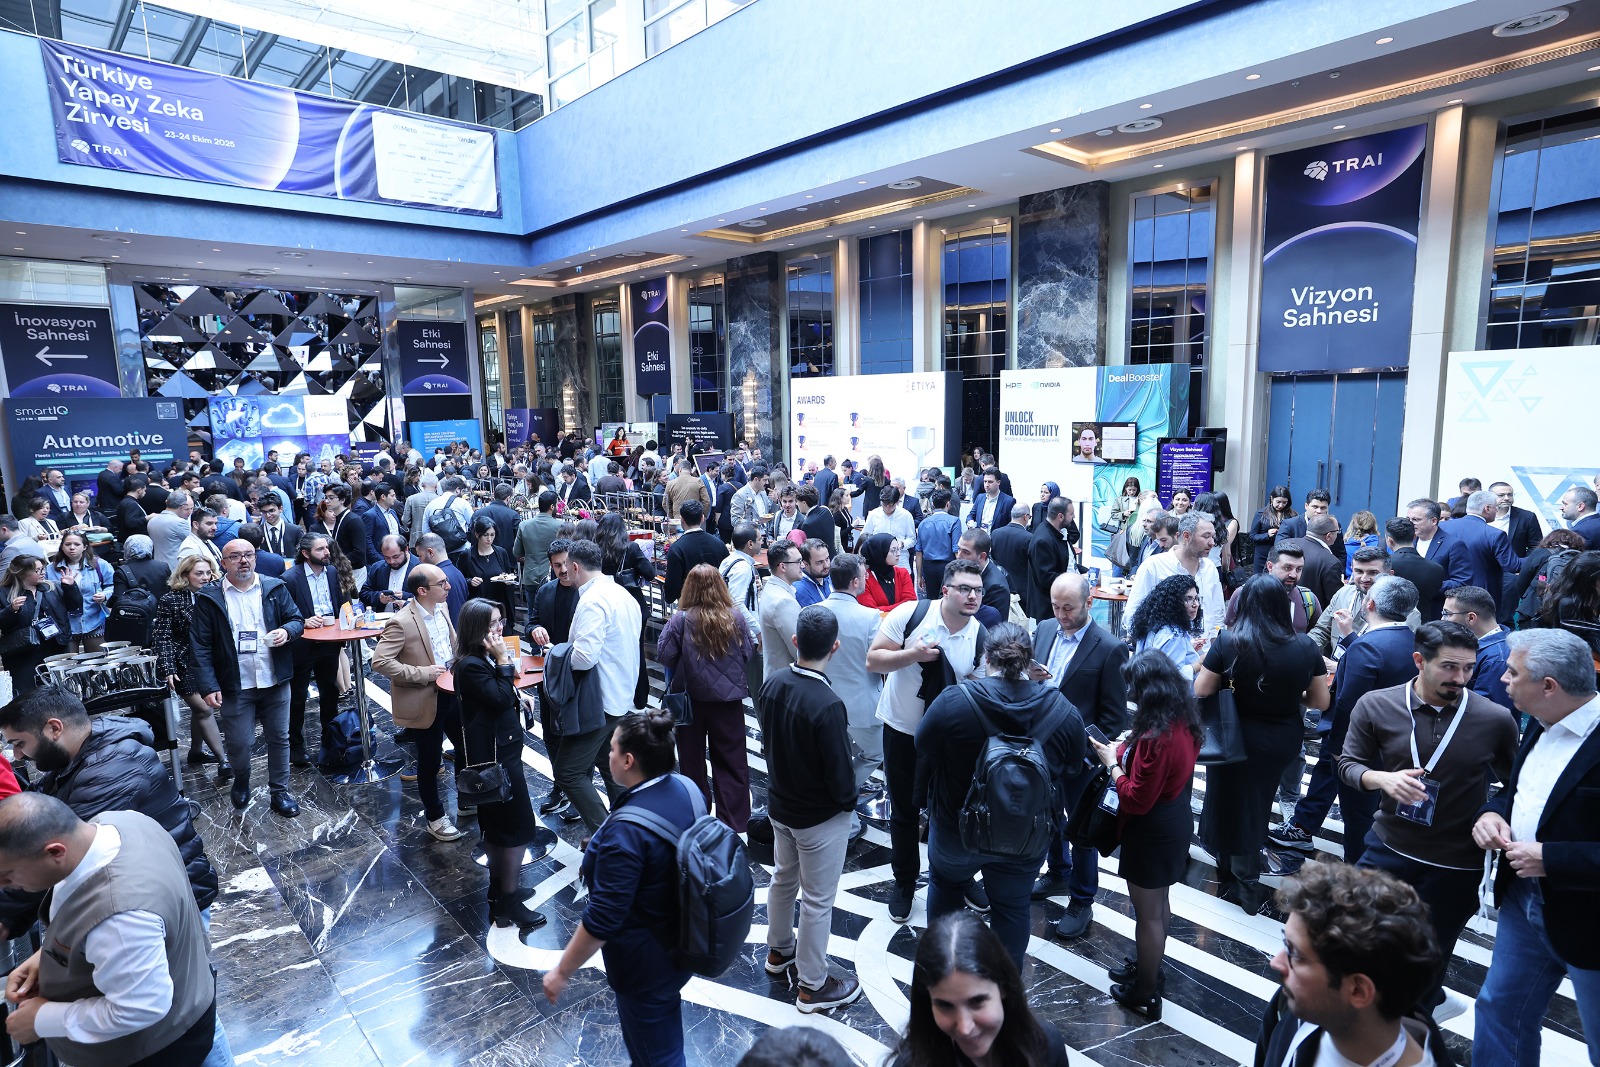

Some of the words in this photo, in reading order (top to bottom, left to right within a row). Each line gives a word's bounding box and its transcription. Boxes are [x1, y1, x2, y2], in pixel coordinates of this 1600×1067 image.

[56, 53, 153, 91] Türkiye
[60, 77, 139, 114] Yapay
[146, 95, 204, 122] Zeka
[64, 102, 150, 133] Zirvesi
[164, 130, 191, 141] 23-24
[192, 135, 212, 145] Ekim
[214, 138, 236, 148] 2025
[92, 143, 128, 156] TRAI
[1332, 152, 1383, 173] TRAI
[648, 290, 660, 298] TRAI
[1291, 285, 1373, 309] Vizyon
[14, 312, 97, 330] İnovasyon
[1283, 302, 1379, 328] Sahnesi
[27, 329, 90, 341] Sahnesi
[422, 329, 441, 338] Etki
[413, 339, 451, 349] Sahnesi
[647, 351, 659, 361] Etki
[641, 361, 666, 372] Sahnesi
[796, 395, 826, 405] AWARDS
[15, 405, 69, 416] smartIQ
[1004, 411, 1034, 423] UNLOCK
[1004, 424, 1060, 437] PRODUCTIVITY
[43, 431, 164, 449] Automotive
